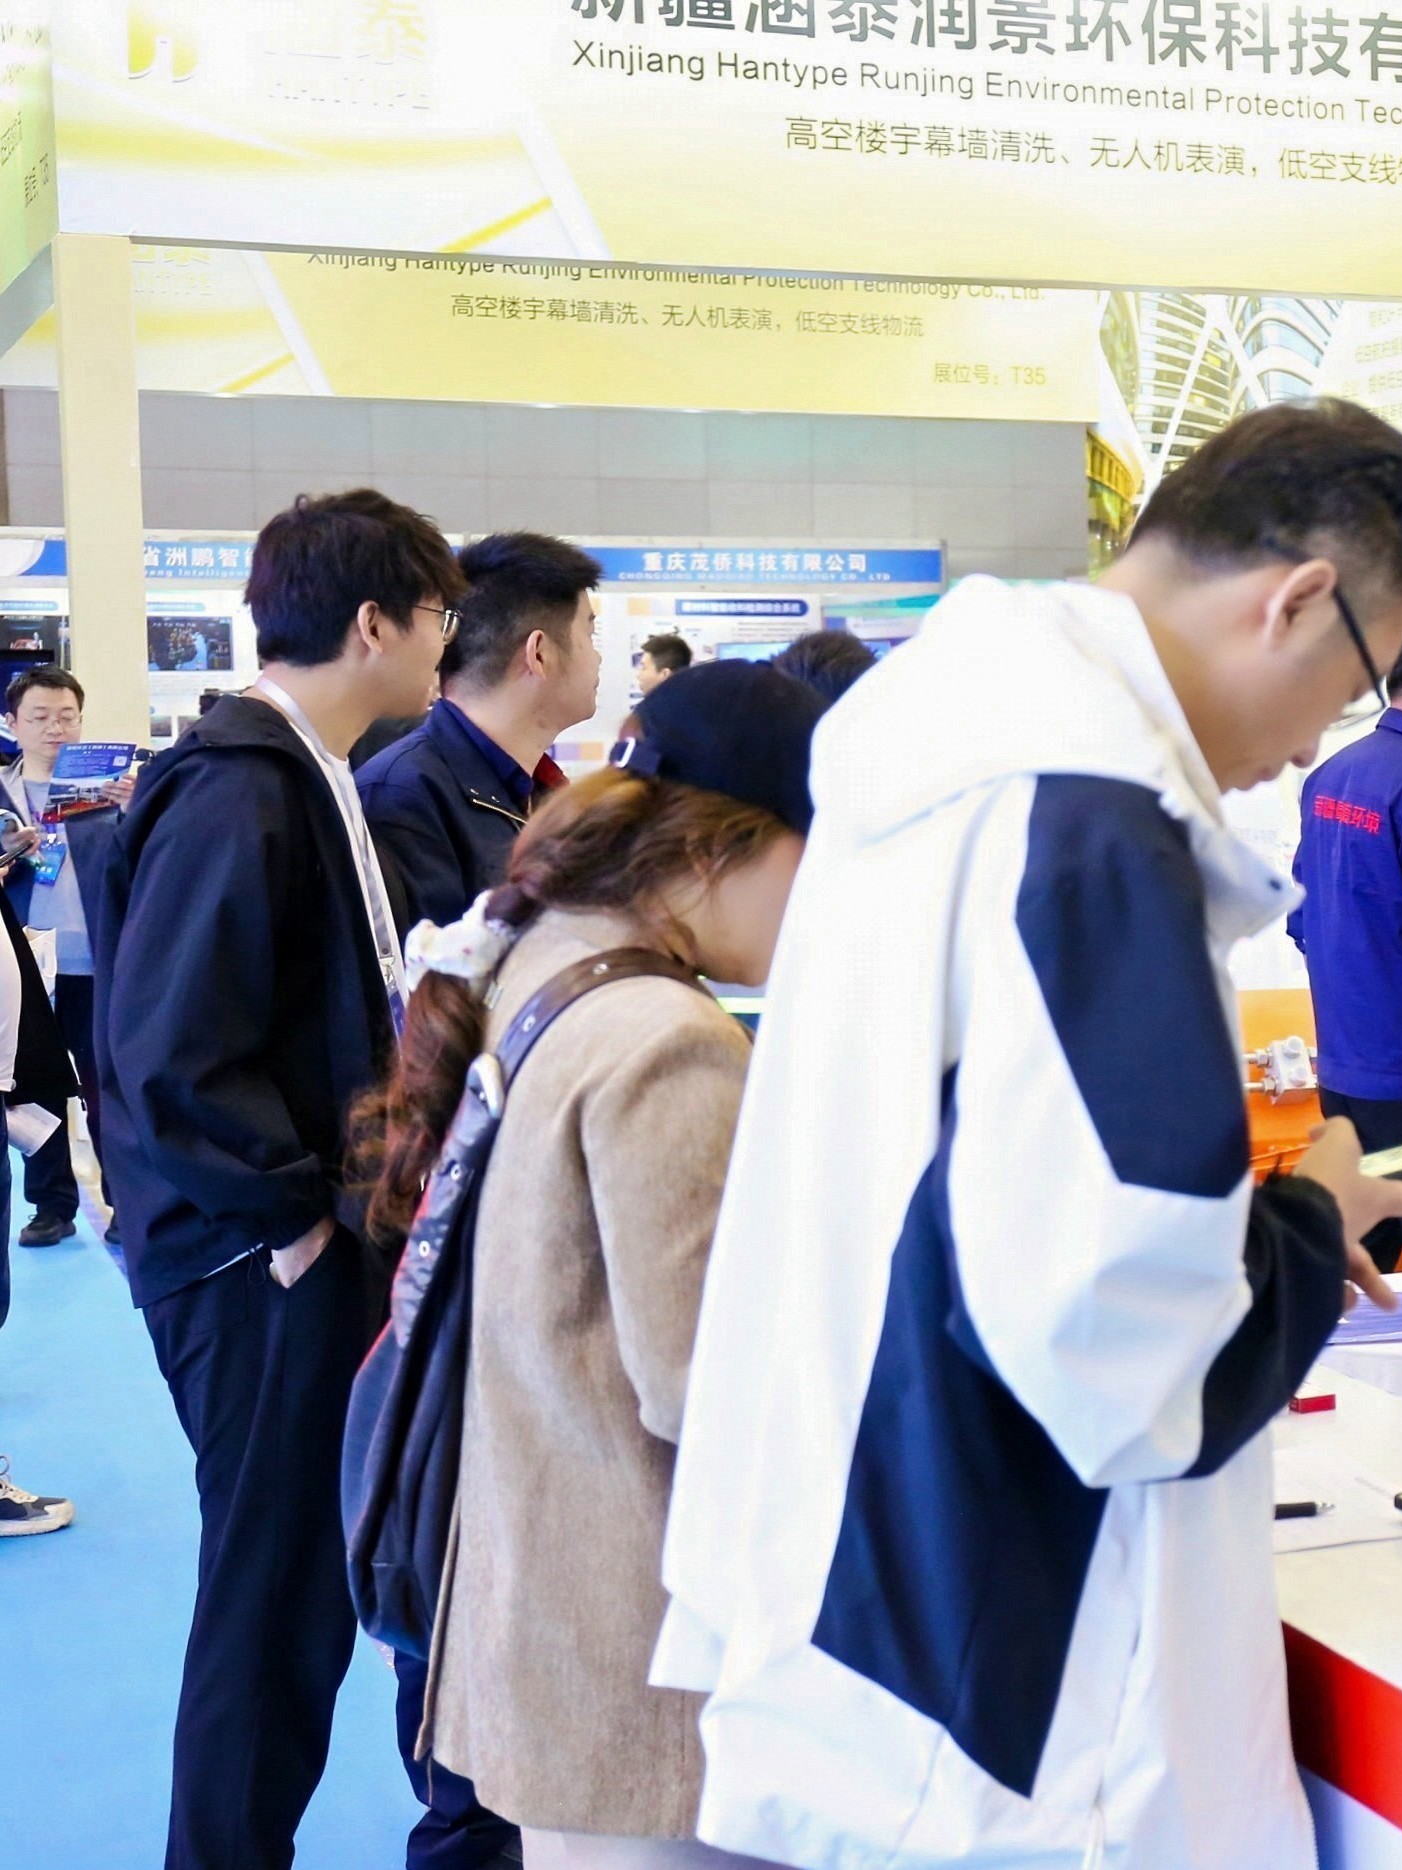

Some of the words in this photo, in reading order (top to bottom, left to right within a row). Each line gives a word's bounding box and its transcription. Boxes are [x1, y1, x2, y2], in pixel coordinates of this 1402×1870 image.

[572, 39, 706, 82] Xinjiang
[717, 52, 848, 89] Hantype
[860, 63, 974, 100] Runjing
[985, 72, 1195, 112] Environmental
[1205, 91, 1345, 121] Protection
[451, 293, 924, 338] 高空楼宇幕墙清洗、无人机表演，低空支线物流
[642, 551, 867, 573] 重庆茂侨科技有限公司
